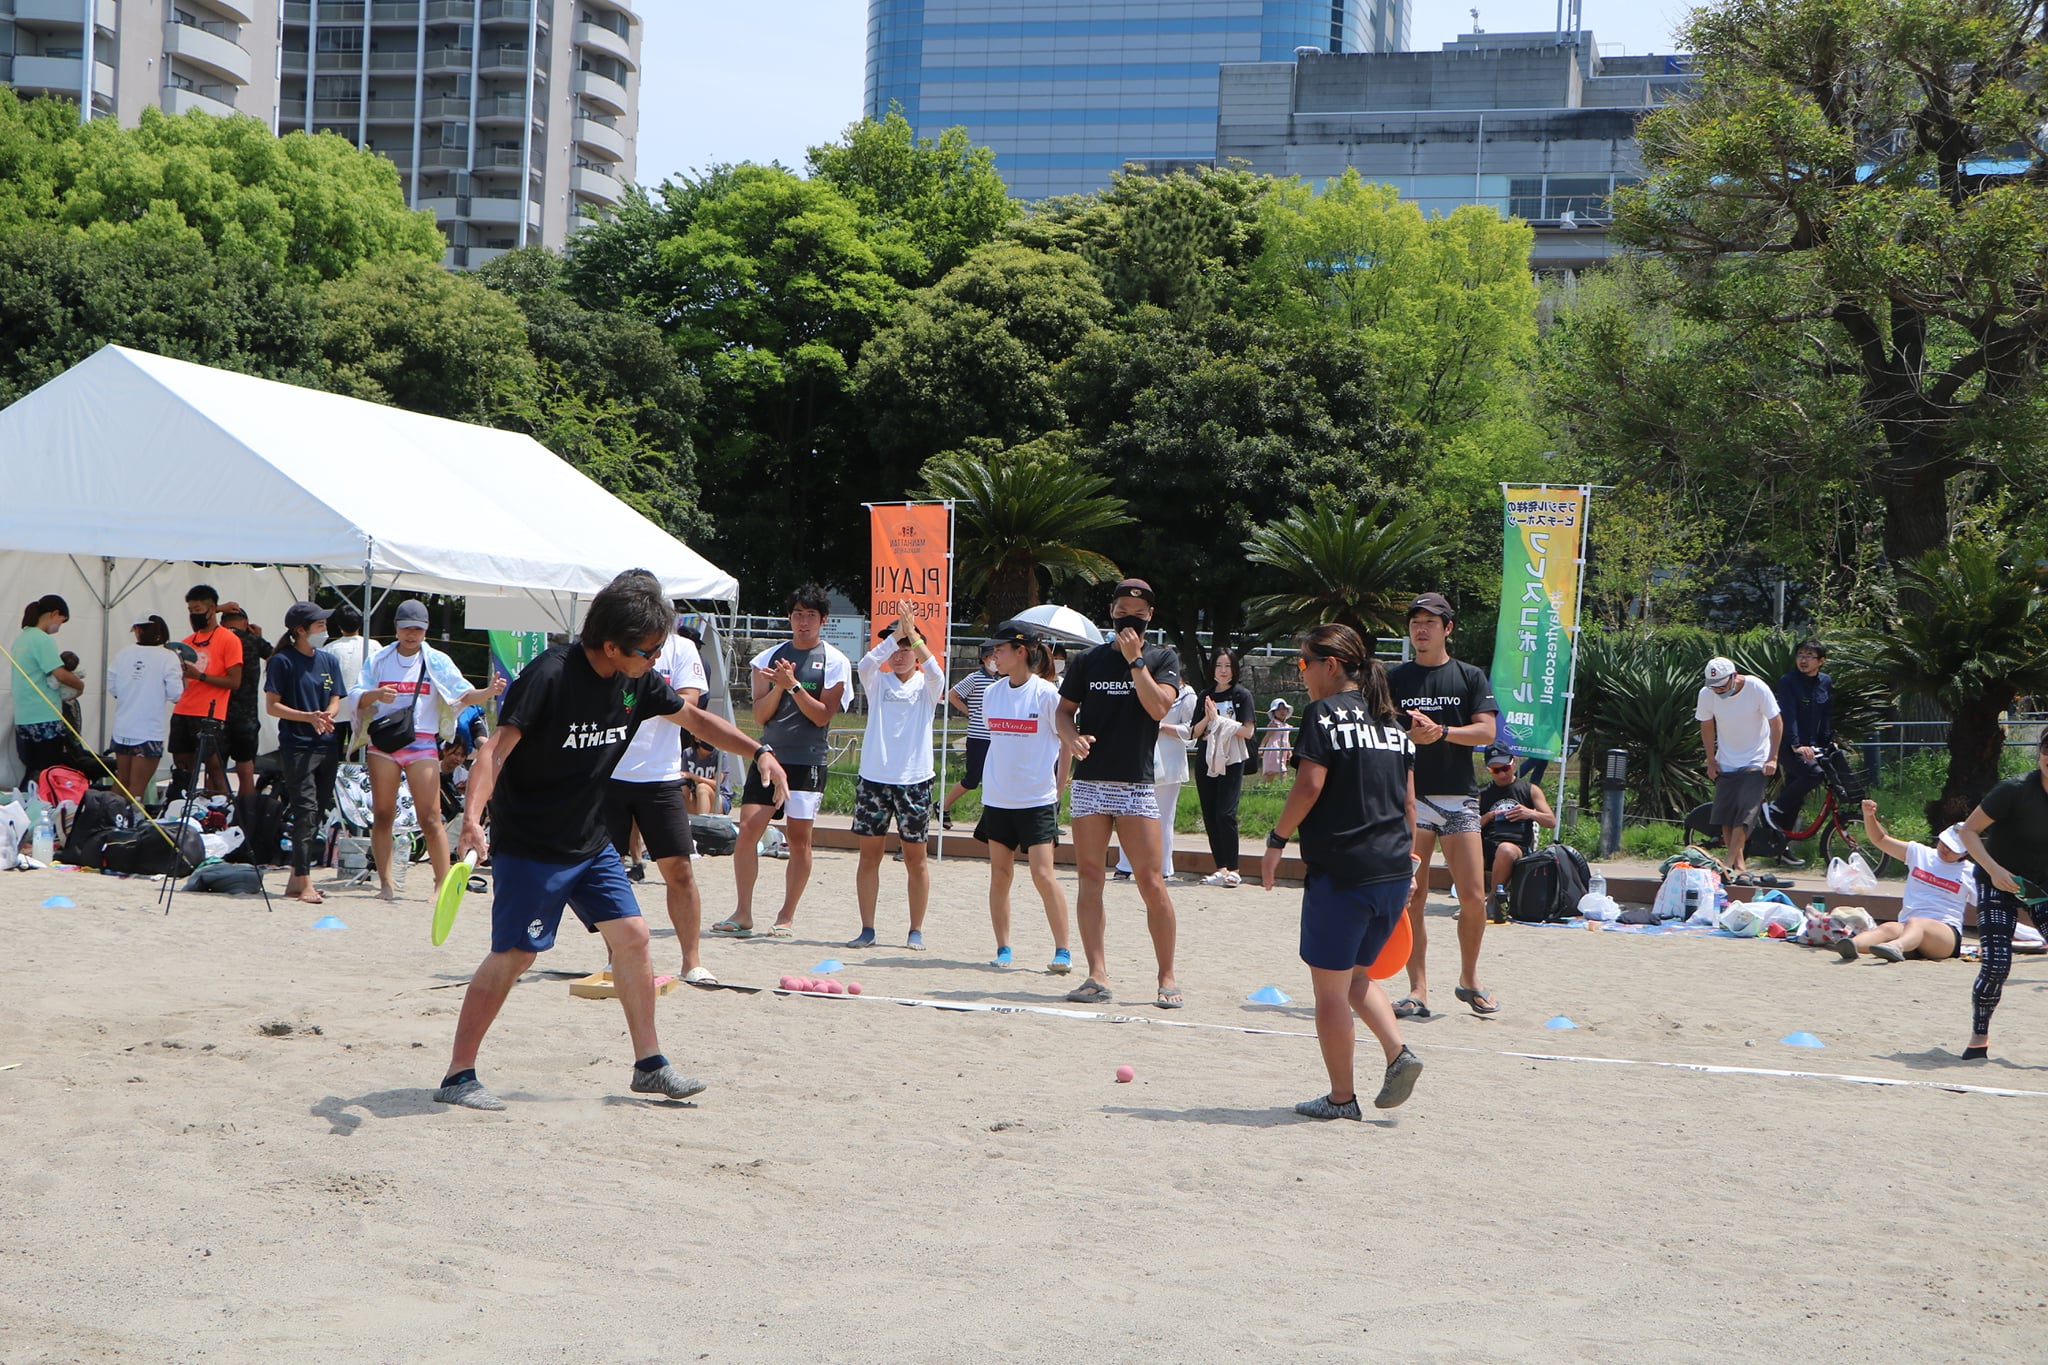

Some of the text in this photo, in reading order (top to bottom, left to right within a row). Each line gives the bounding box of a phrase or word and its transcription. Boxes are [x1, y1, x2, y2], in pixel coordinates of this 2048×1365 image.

[802, 682, 817, 690] RKS
[1089, 681, 1136, 690] PODERAT
[1401, 696, 1461, 708] PODERATIVO
[562, 725, 628, 749] ATHLET
